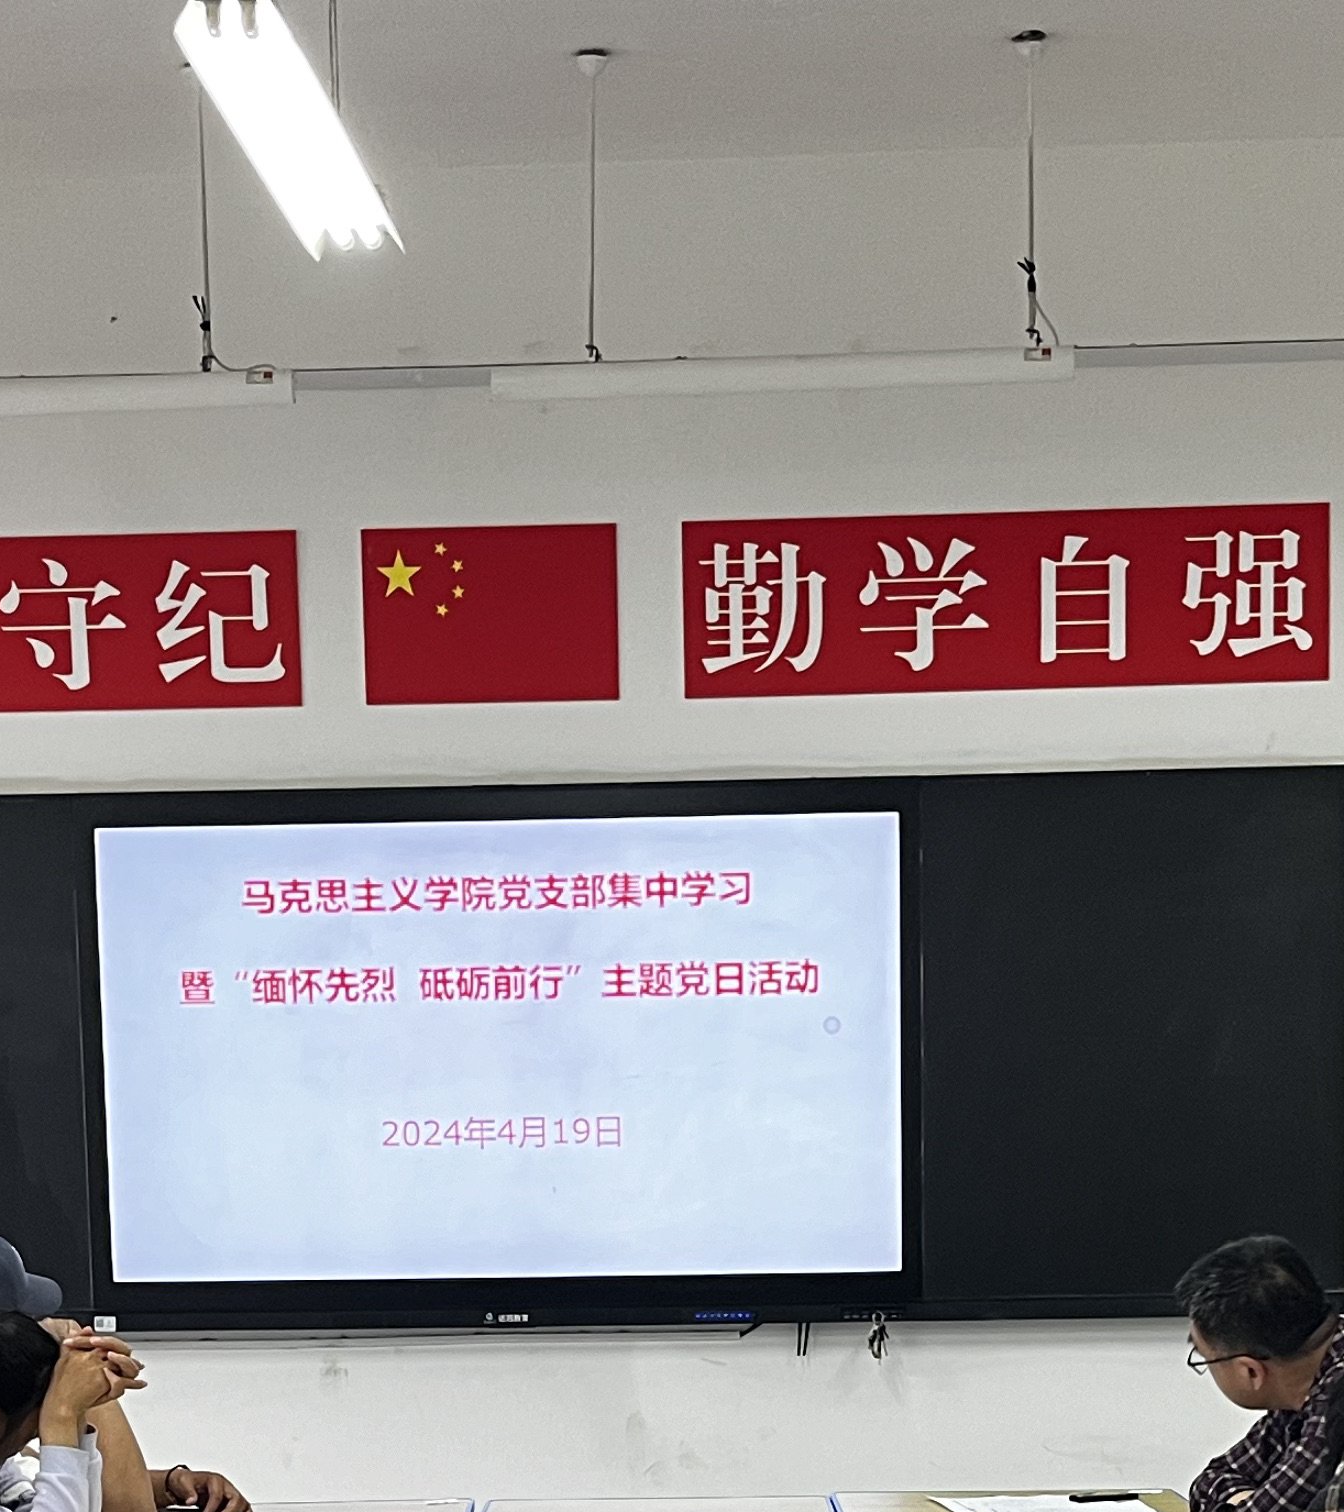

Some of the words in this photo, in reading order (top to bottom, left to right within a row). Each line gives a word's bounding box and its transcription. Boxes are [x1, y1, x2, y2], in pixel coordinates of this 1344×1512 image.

[698, 529, 1313, 674] 勤学自强
[243, 871, 752, 915] 马克思主义学院党支部集中学习
[382, 1116, 623, 1149] 2024年4月19日
